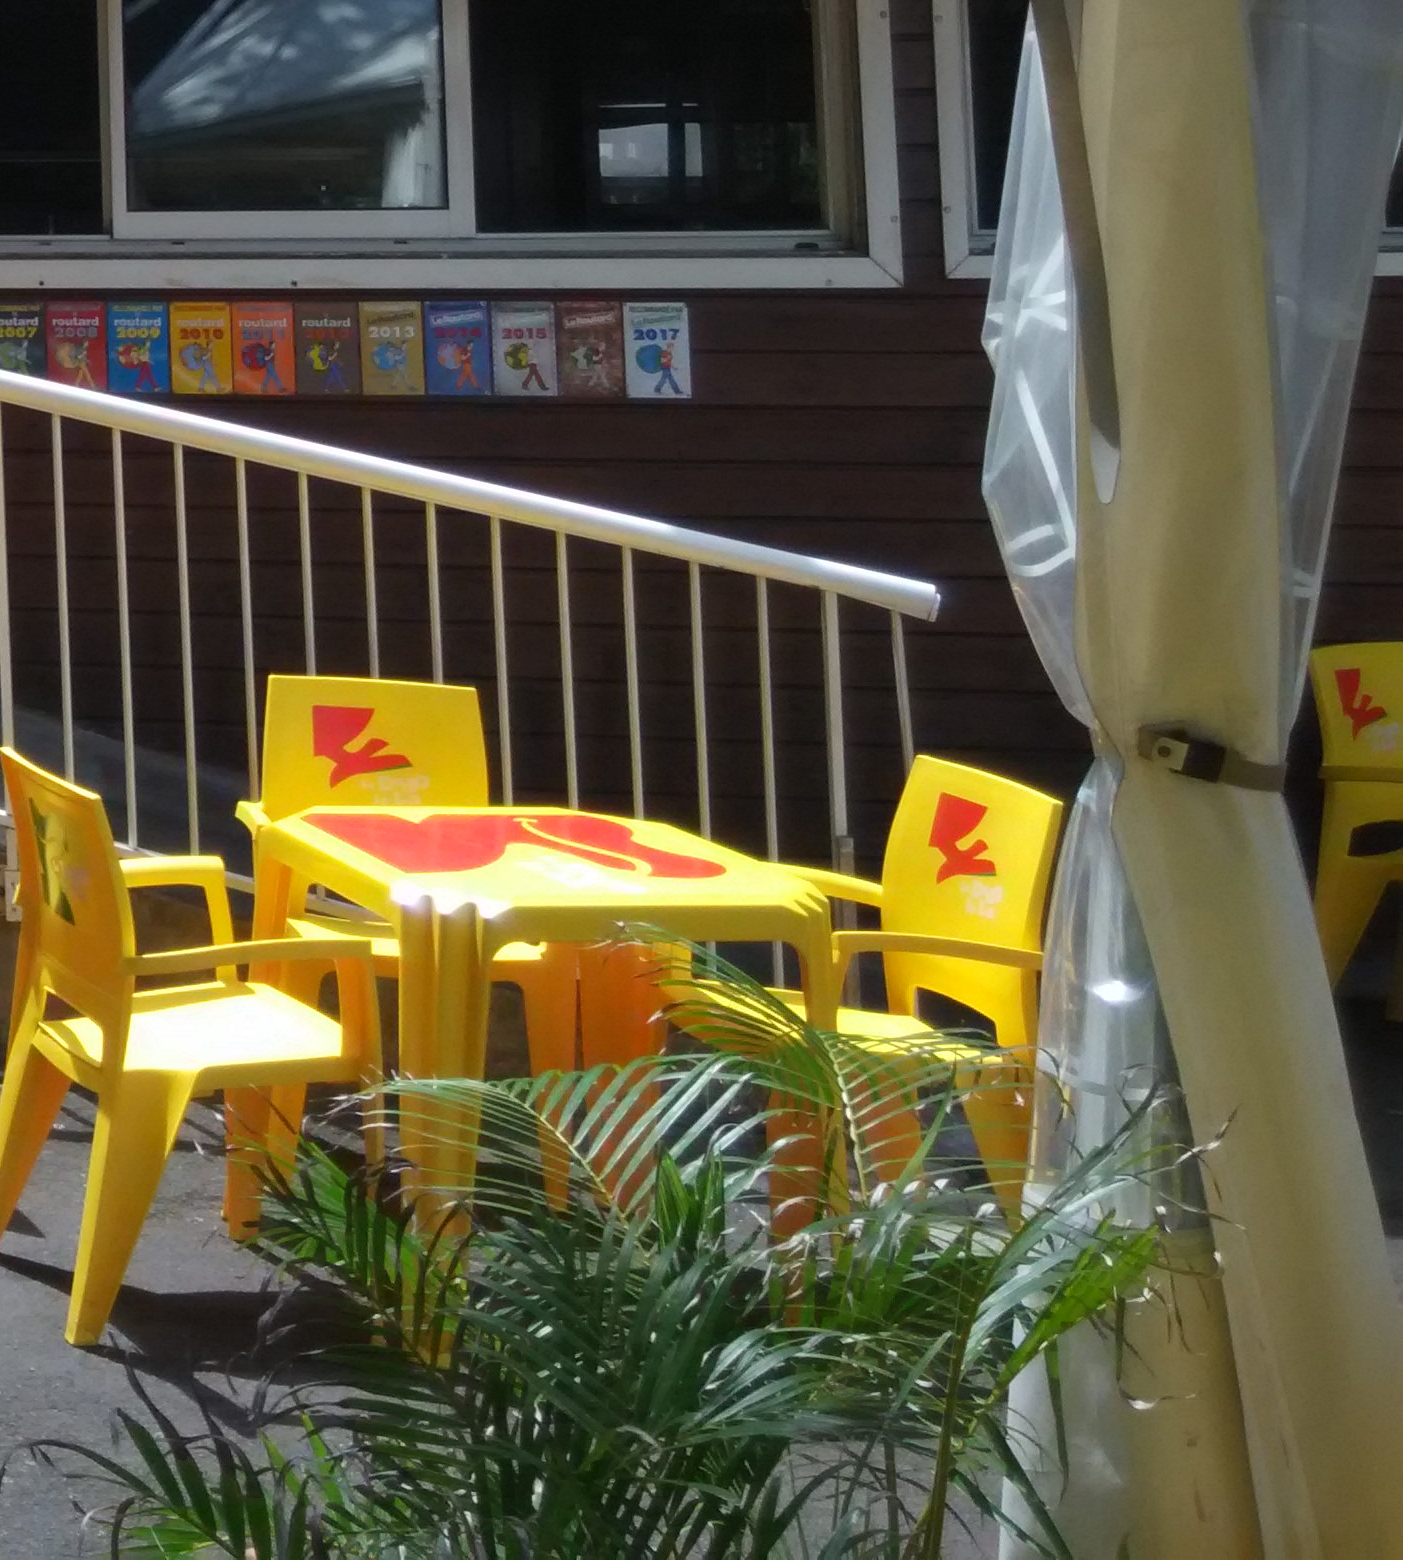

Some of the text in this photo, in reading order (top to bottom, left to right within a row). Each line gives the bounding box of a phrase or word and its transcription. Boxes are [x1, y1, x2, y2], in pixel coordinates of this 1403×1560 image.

[52, 317, 100, 326] routard
[114, 317, 162, 327] routard
[238, 318, 288, 327] routard
[302, 317, 351, 327] routard
[54, 328, 98, 338] 2008
[116, 328, 161, 338] 2009
[179, 329, 224, 339] 2010
[368, 326, 416, 338] 2013
[502, 328, 547, 339] 2015
[633, 328, 680, 340] 2017
